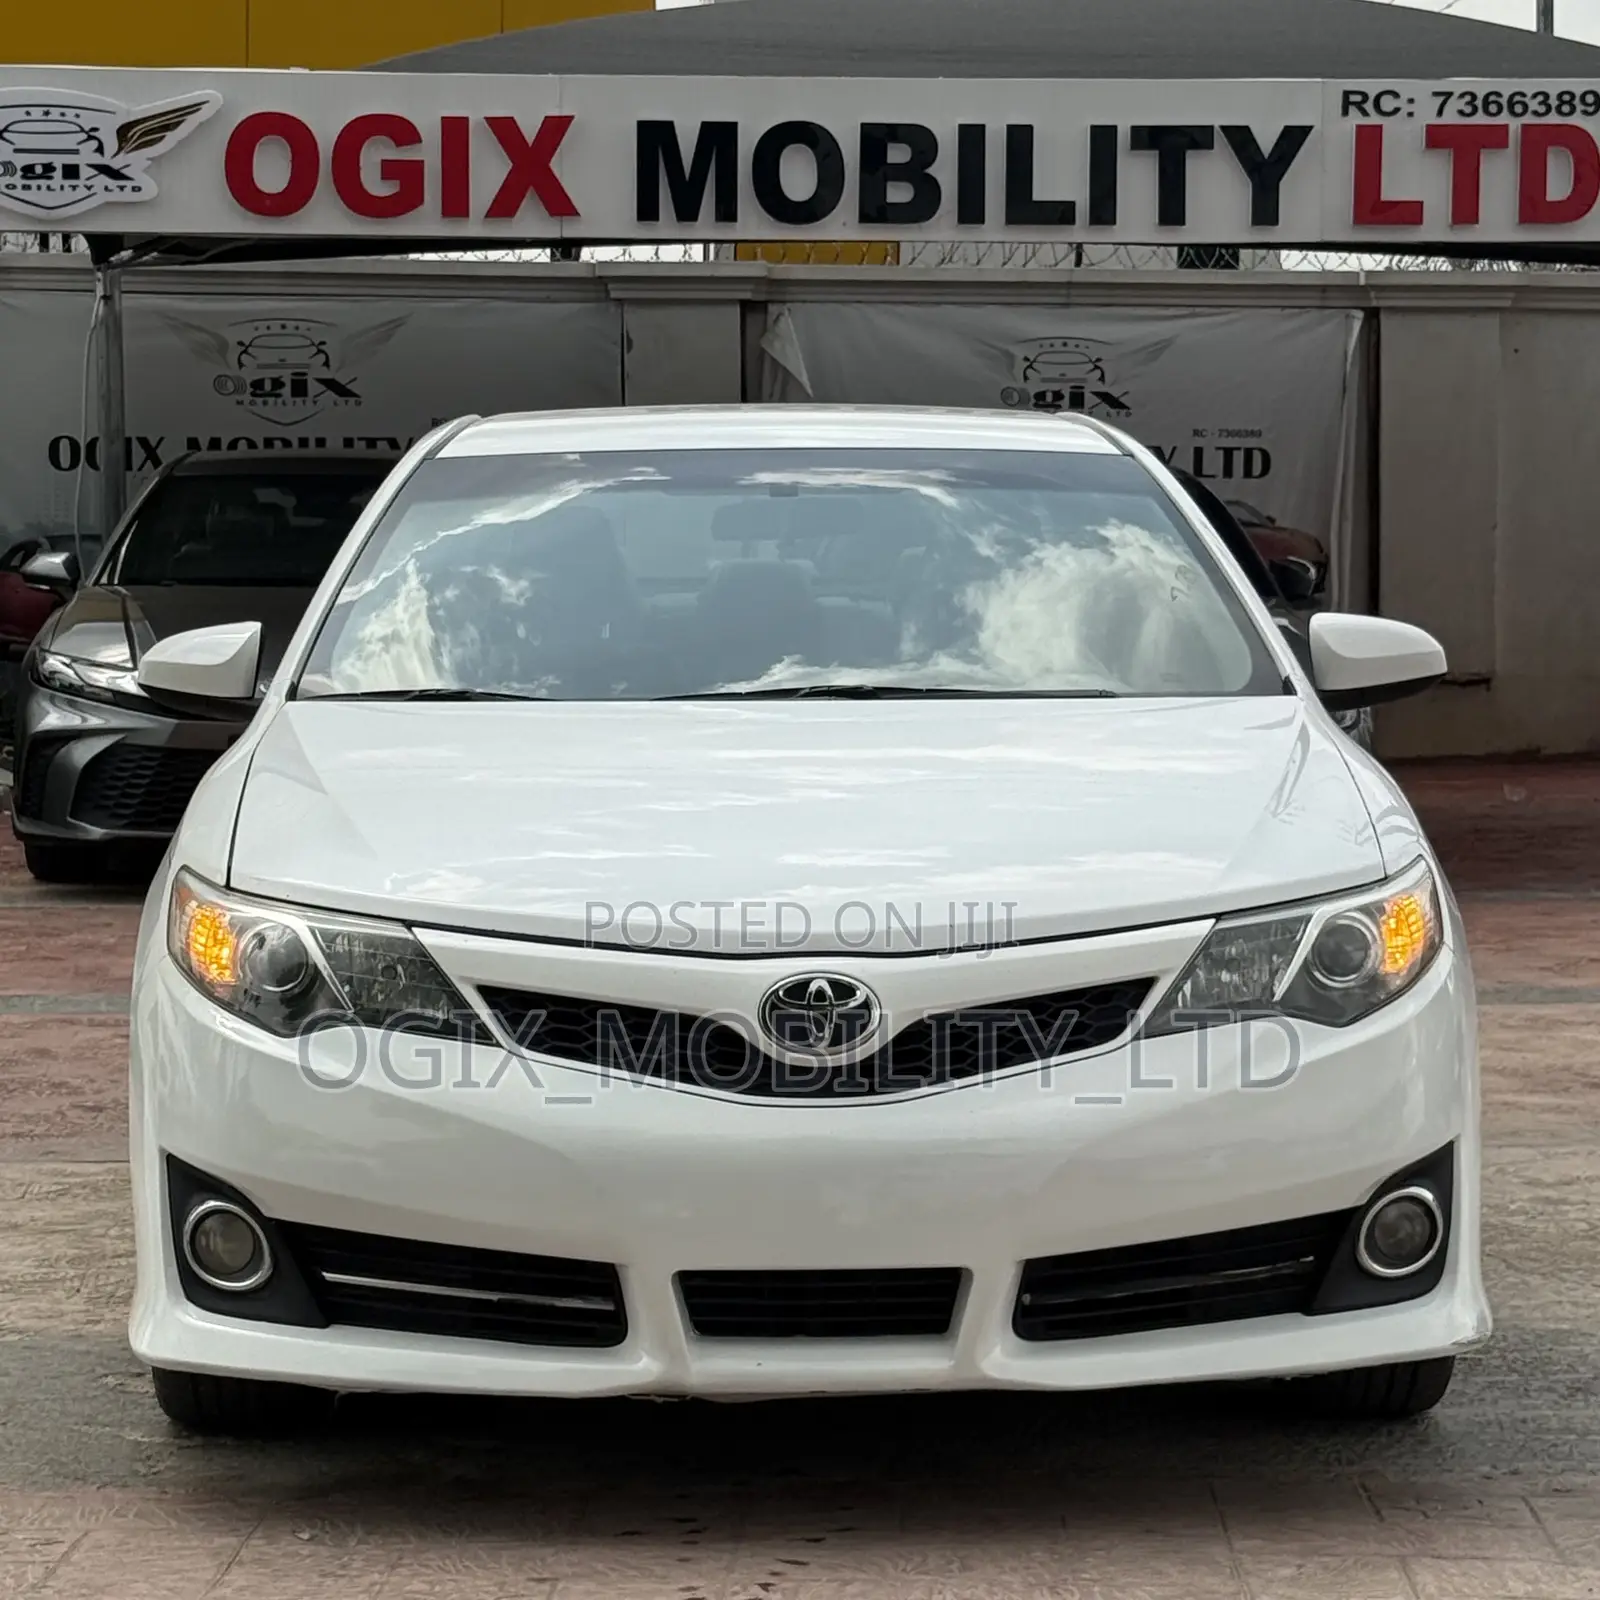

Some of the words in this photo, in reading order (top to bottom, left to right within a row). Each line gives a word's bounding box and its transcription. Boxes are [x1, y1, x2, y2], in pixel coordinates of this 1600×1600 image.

[1341, 89, 1416, 118] RC:
[1431, 90, 1600, 118] 7366389
[224, 111, 581, 219] OGIX
[636, 120, 1314, 226] MOBILITY
[1353, 123, 1600, 226] LTD
[0, 182, 95, 192] OBILITY
[103, 184, 143, 193] LTD
[1193, 446, 1272, 479] LTD
